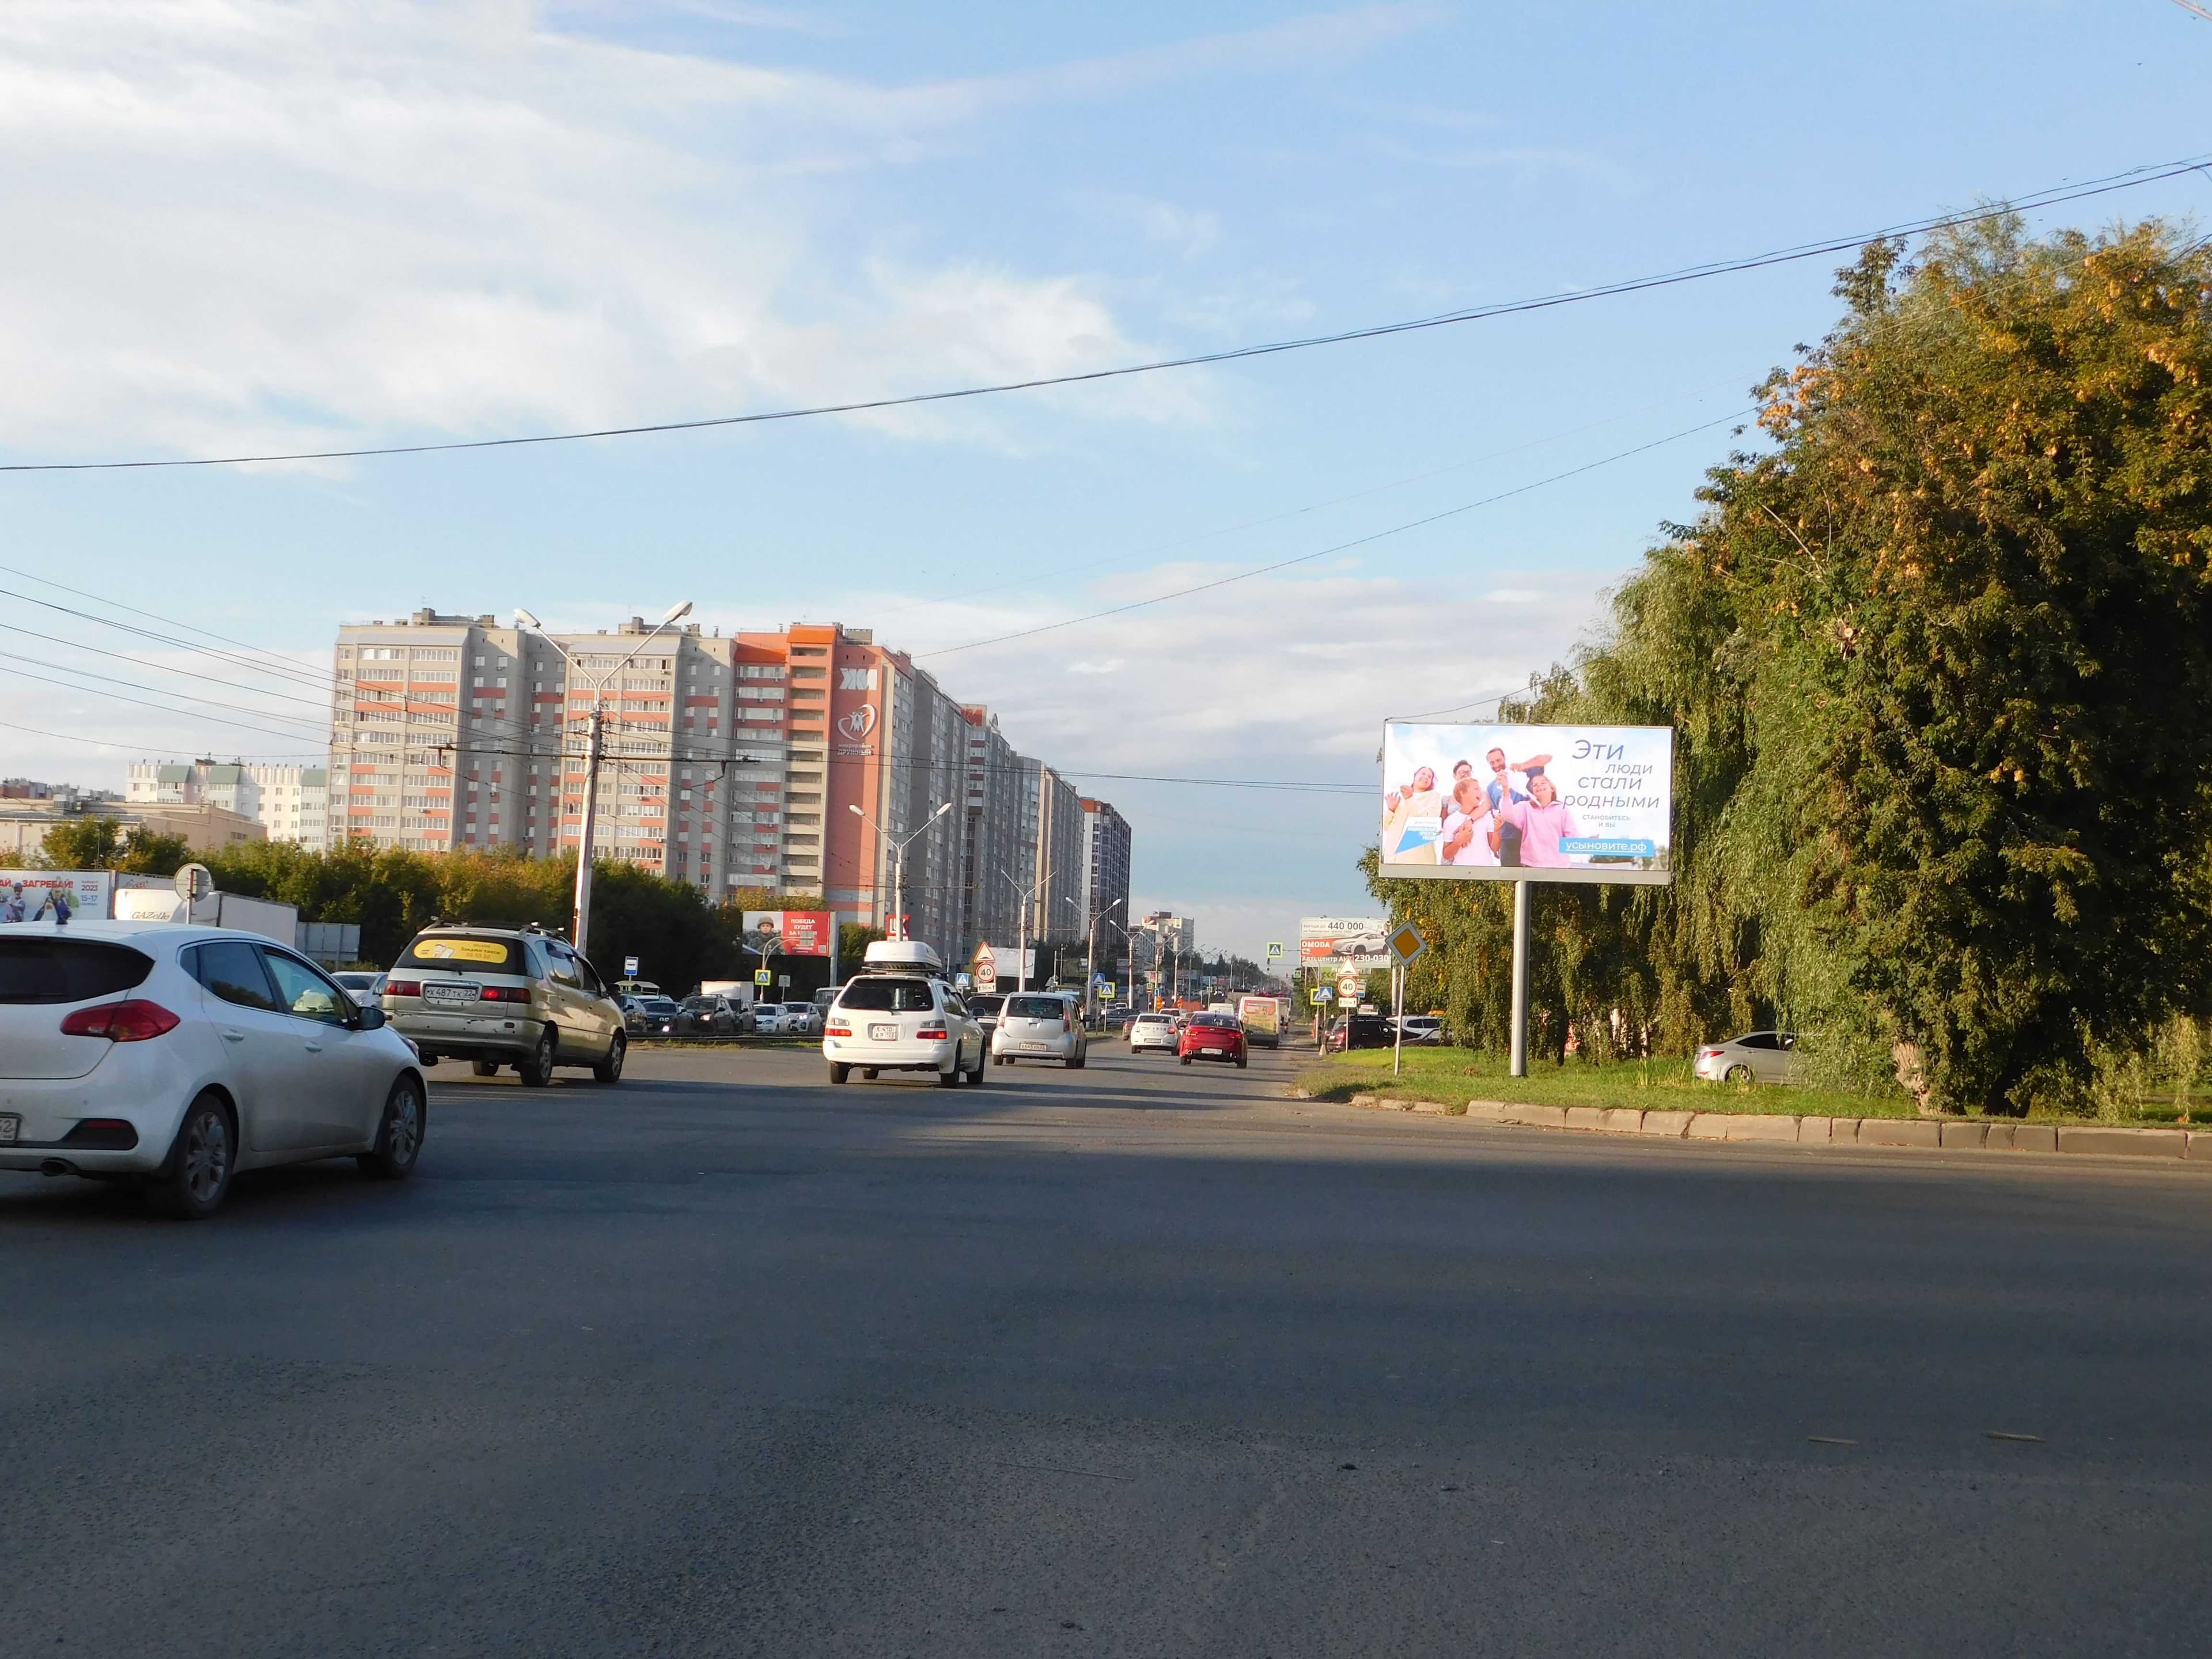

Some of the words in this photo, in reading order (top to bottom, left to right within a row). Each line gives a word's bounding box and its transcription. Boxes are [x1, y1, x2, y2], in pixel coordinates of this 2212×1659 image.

[1572, 740, 1624, 760] Эти
[1605, 764, 1653, 775] люди
[1578, 777, 1642, 790] стали
[1562, 795, 1660, 809] родными
[1565, 842, 1646, 853] усыновите.рф
[22, 878, 73, 888] ЗАГРЕБАЙ!
[1328, 922, 1344, 930] 440
[1347, 922, 1364, 930] 000
[1354, 954, 1389, 962] 230-030
